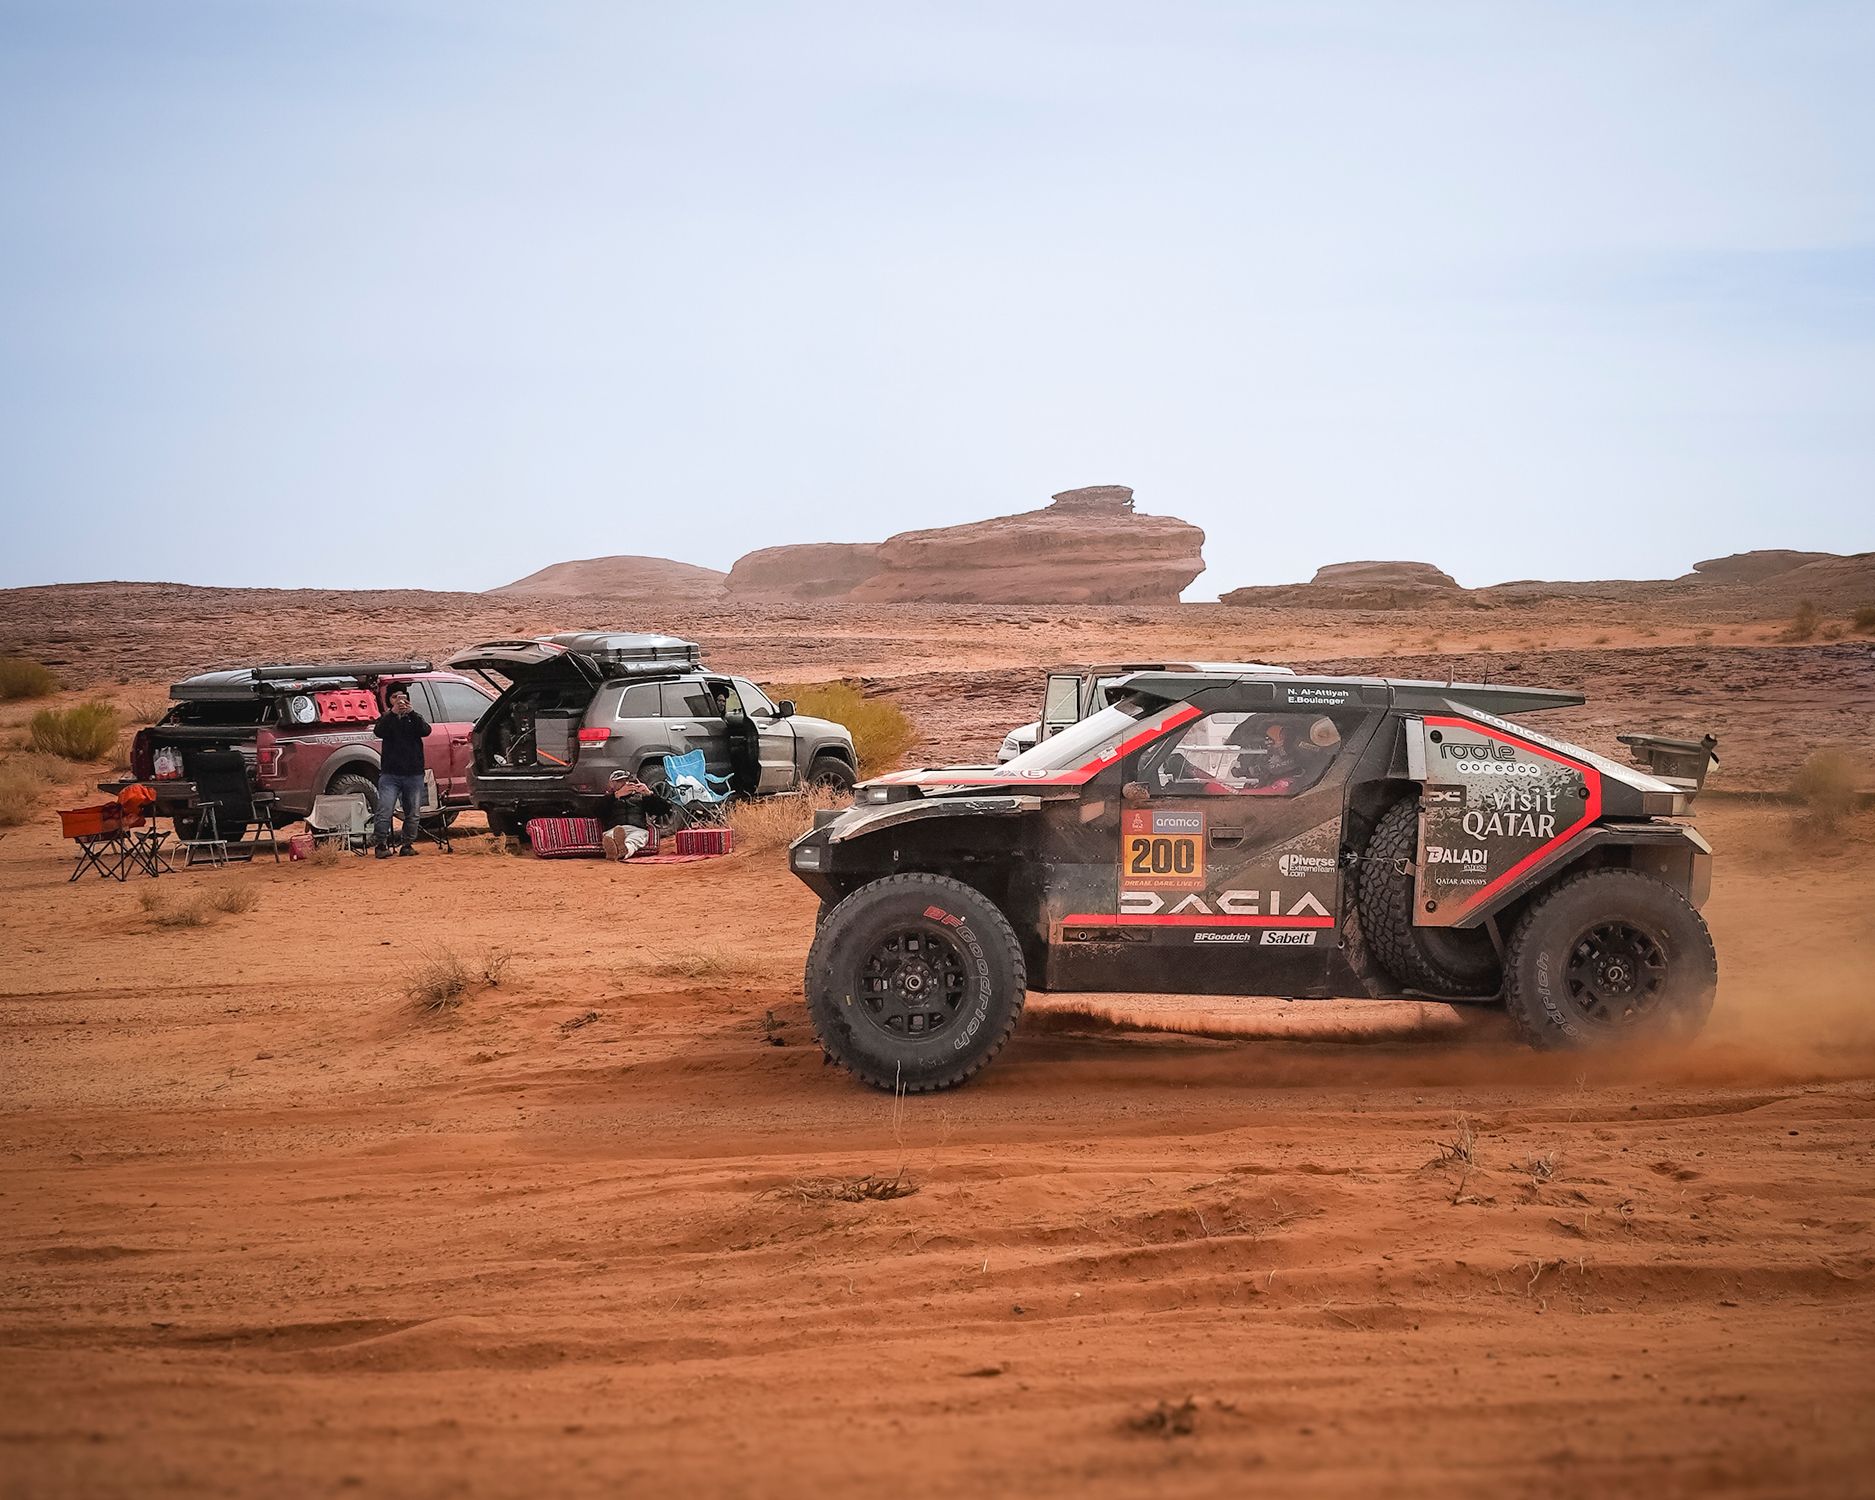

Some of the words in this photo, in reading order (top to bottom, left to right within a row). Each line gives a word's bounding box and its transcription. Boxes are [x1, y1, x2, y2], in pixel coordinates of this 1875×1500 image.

[1288, 696, 1345, 705] E.Boulanger
[1301, 688, 1349, 698] Al-Attiyah
[1472, 709, 1546, 742] aramco
[1459, 762, 1539, 775] ooredoo
[1492, 786, 1557, 813] visit
[1156, 818, 1200, 827] aramco
[1462, 811, 1556, 841] QATAR
[1131, 838, 1195, 874] 200
[1290, 854, 1335, 867] Diverse
[1426, 846, 1488, 864] BALADI
[1290, 865, 1335, 873] ExtremeTeam
[1120, 890, 1331, 916] DACIA
[1194, 932, 1250, 942] BFGoodrich
[1266, 932, 1310, 944] Sabelt
[923, 905, 992, 1050] BFGoodrich
[1536, 951, 1579, 1037] odrich
